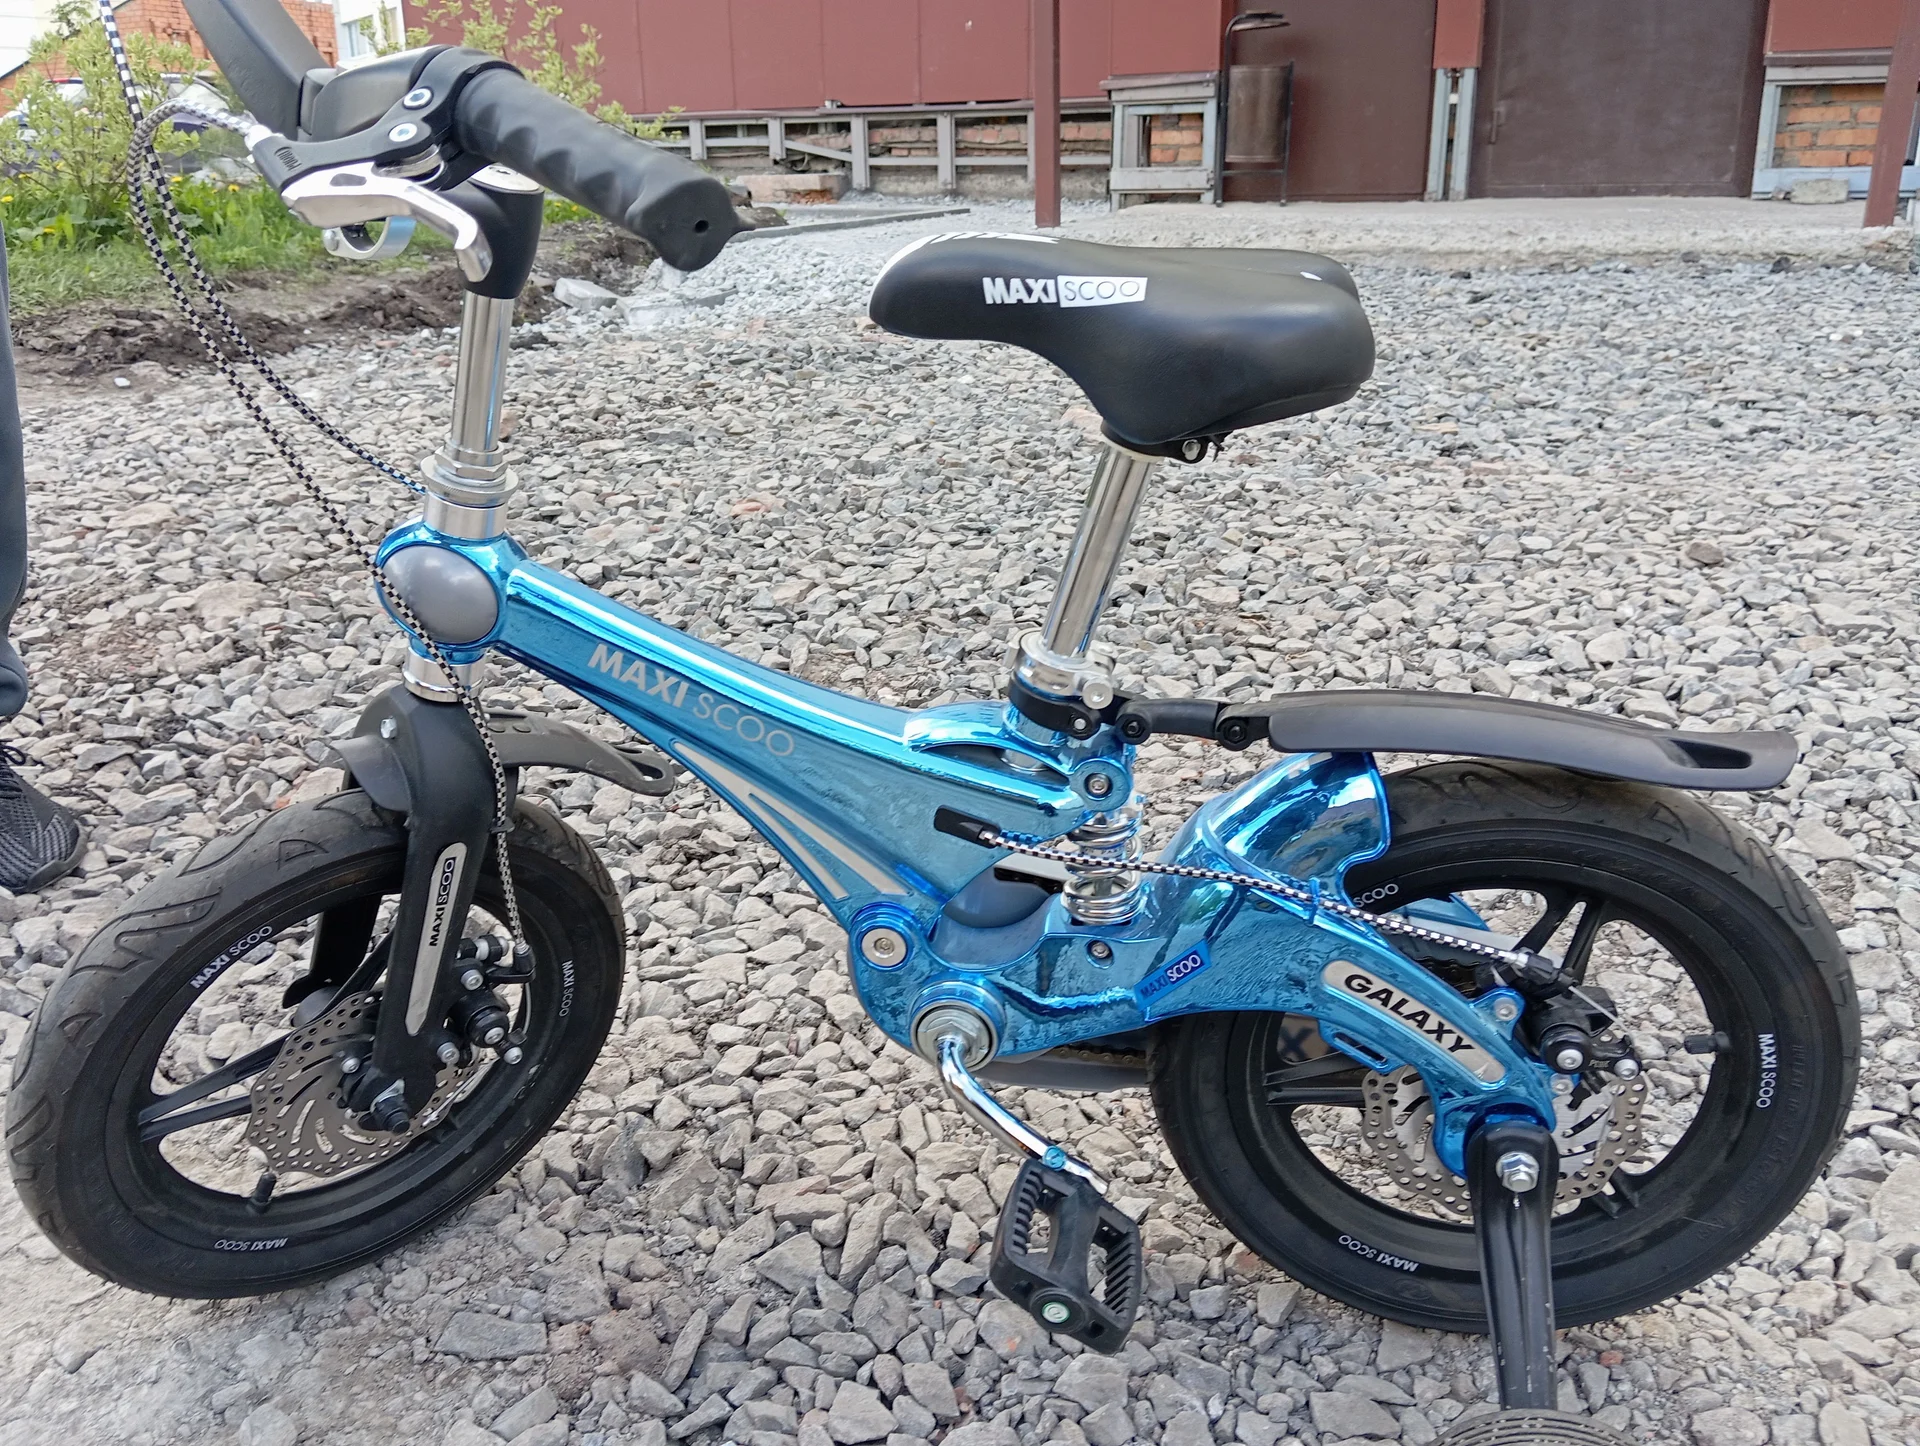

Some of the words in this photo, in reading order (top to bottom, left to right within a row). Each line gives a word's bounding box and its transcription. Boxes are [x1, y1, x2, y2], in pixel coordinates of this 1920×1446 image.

[982, 277, 1058, 305] MAXI
[1064, 281, 1140, 301] SCOO
[587, 643, 690, 708] MAXI
[692, 692, 795, 757] SCOO
[429, 907, 446, 947] MAXI
[438, 859, 455, 903] SCOO
[1353, 883, 1399, 908] SCOO
[190, 954, 231, 989] MAXI
[229, 926, 273, 956] SCOO
[1166, 954, 1201, 982] SCOO
[561, 960, 575, 988] MAXI
[558, 987, 575, 1017] SCOO
[1344, 974, 1475, 1053] GALAXY
[1757, 1033, 1777, 1069] MAXI
[1755, 1071, 1777, 1108] SCOO
[213, 1239, 251, 1251] SCOO
[249, 1237, 289, 1251] MAXI
[1338, 1234, 1378, 1259] SCOO
[1375, 1252, 1419, 1272] MAXI
